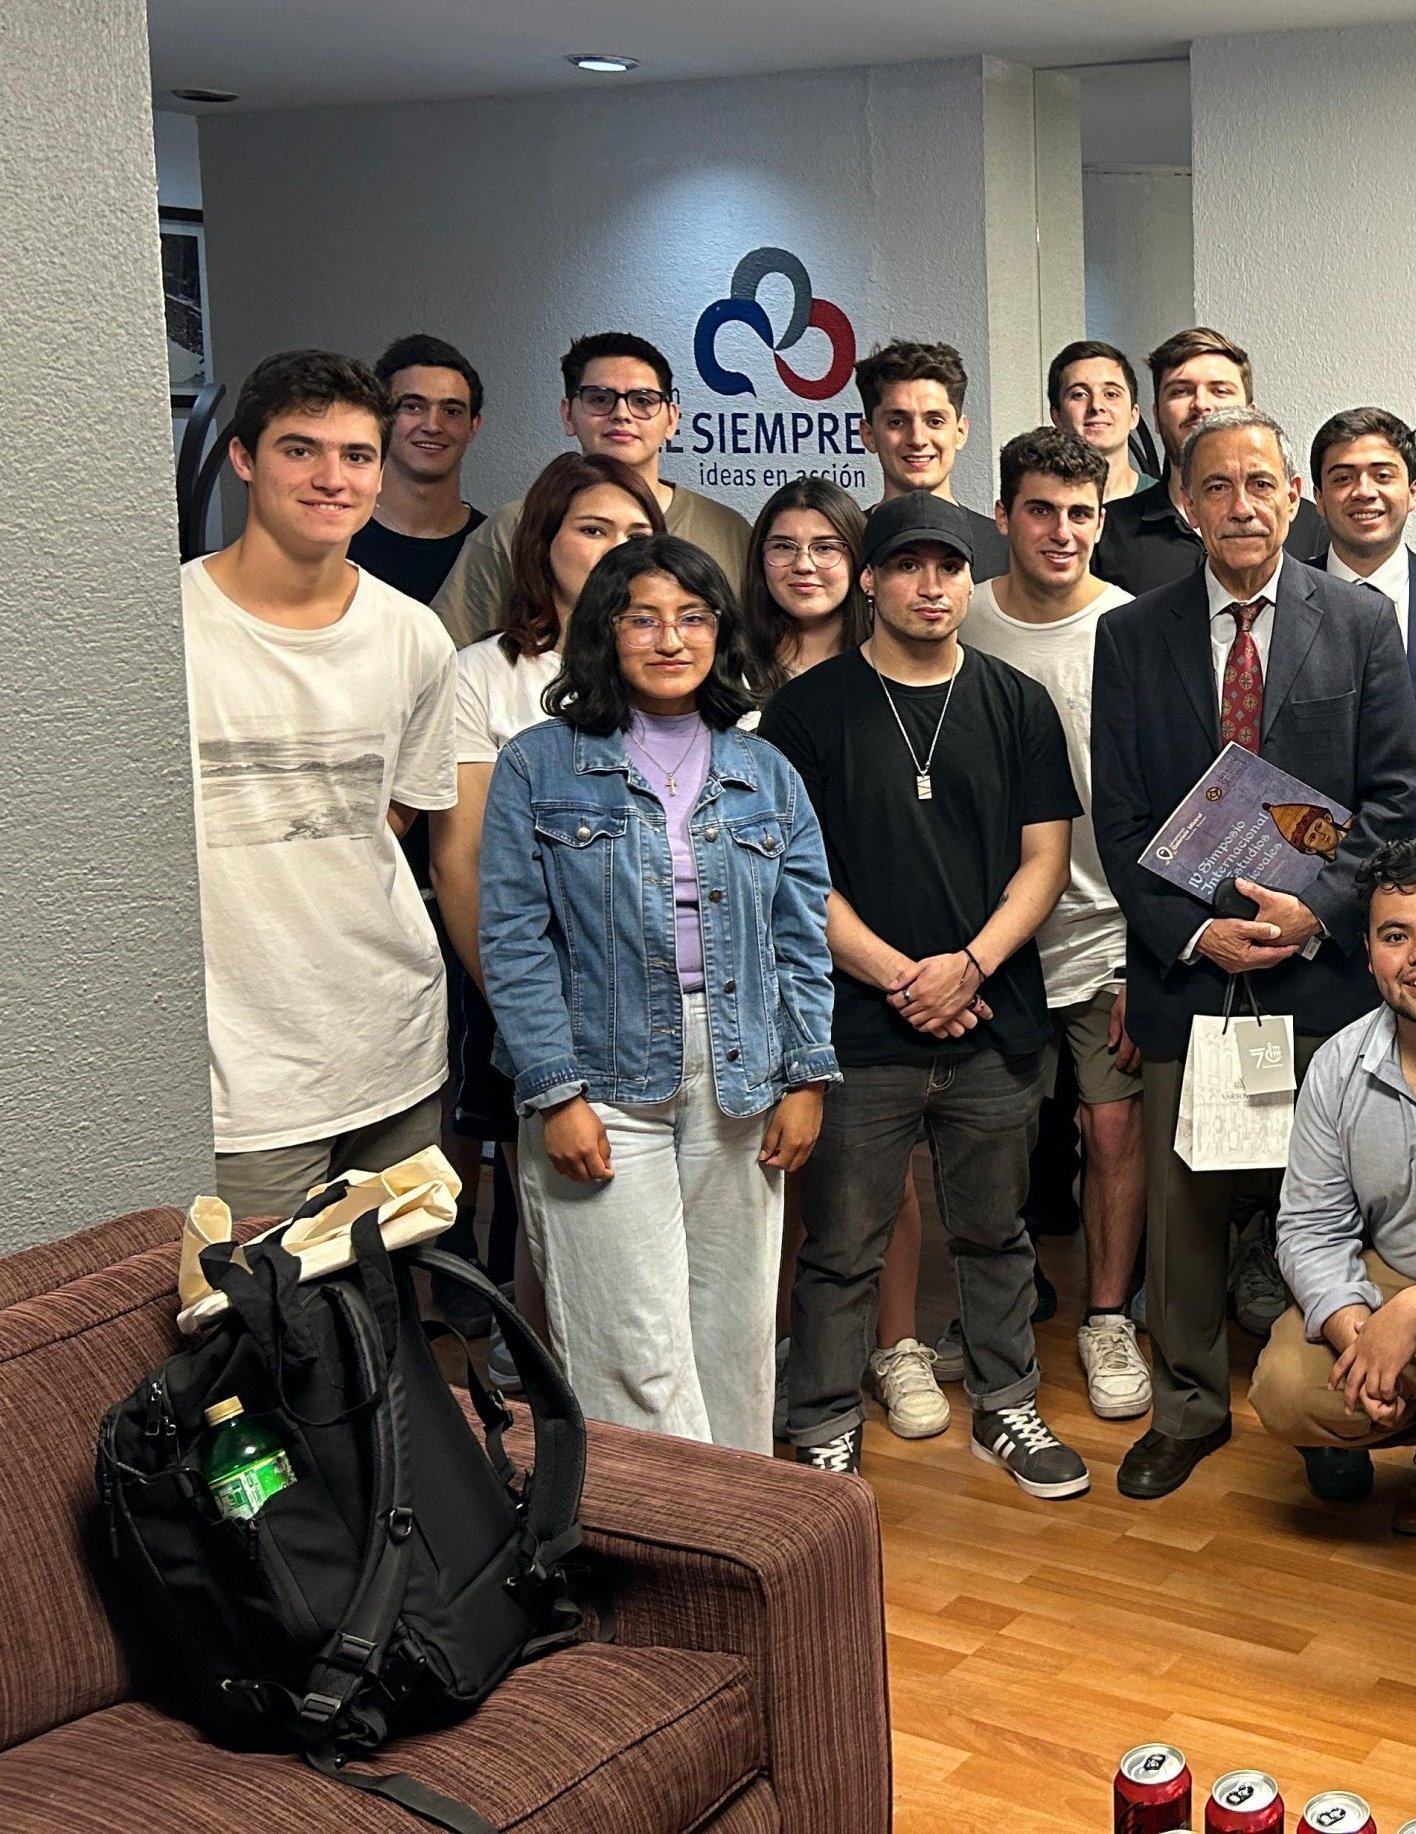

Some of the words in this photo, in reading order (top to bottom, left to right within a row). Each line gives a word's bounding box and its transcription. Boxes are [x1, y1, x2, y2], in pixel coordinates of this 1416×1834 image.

[692, 412, 866, 455] SIEMPRE
[700, 462, 756, 487] ideas
[763, 468, 787, 487] en
[1198, 821, 1246, 874] Simposio
[1201, 812, 1269, 895] Internacional
[1244, 843, 1282, 881] ievales
